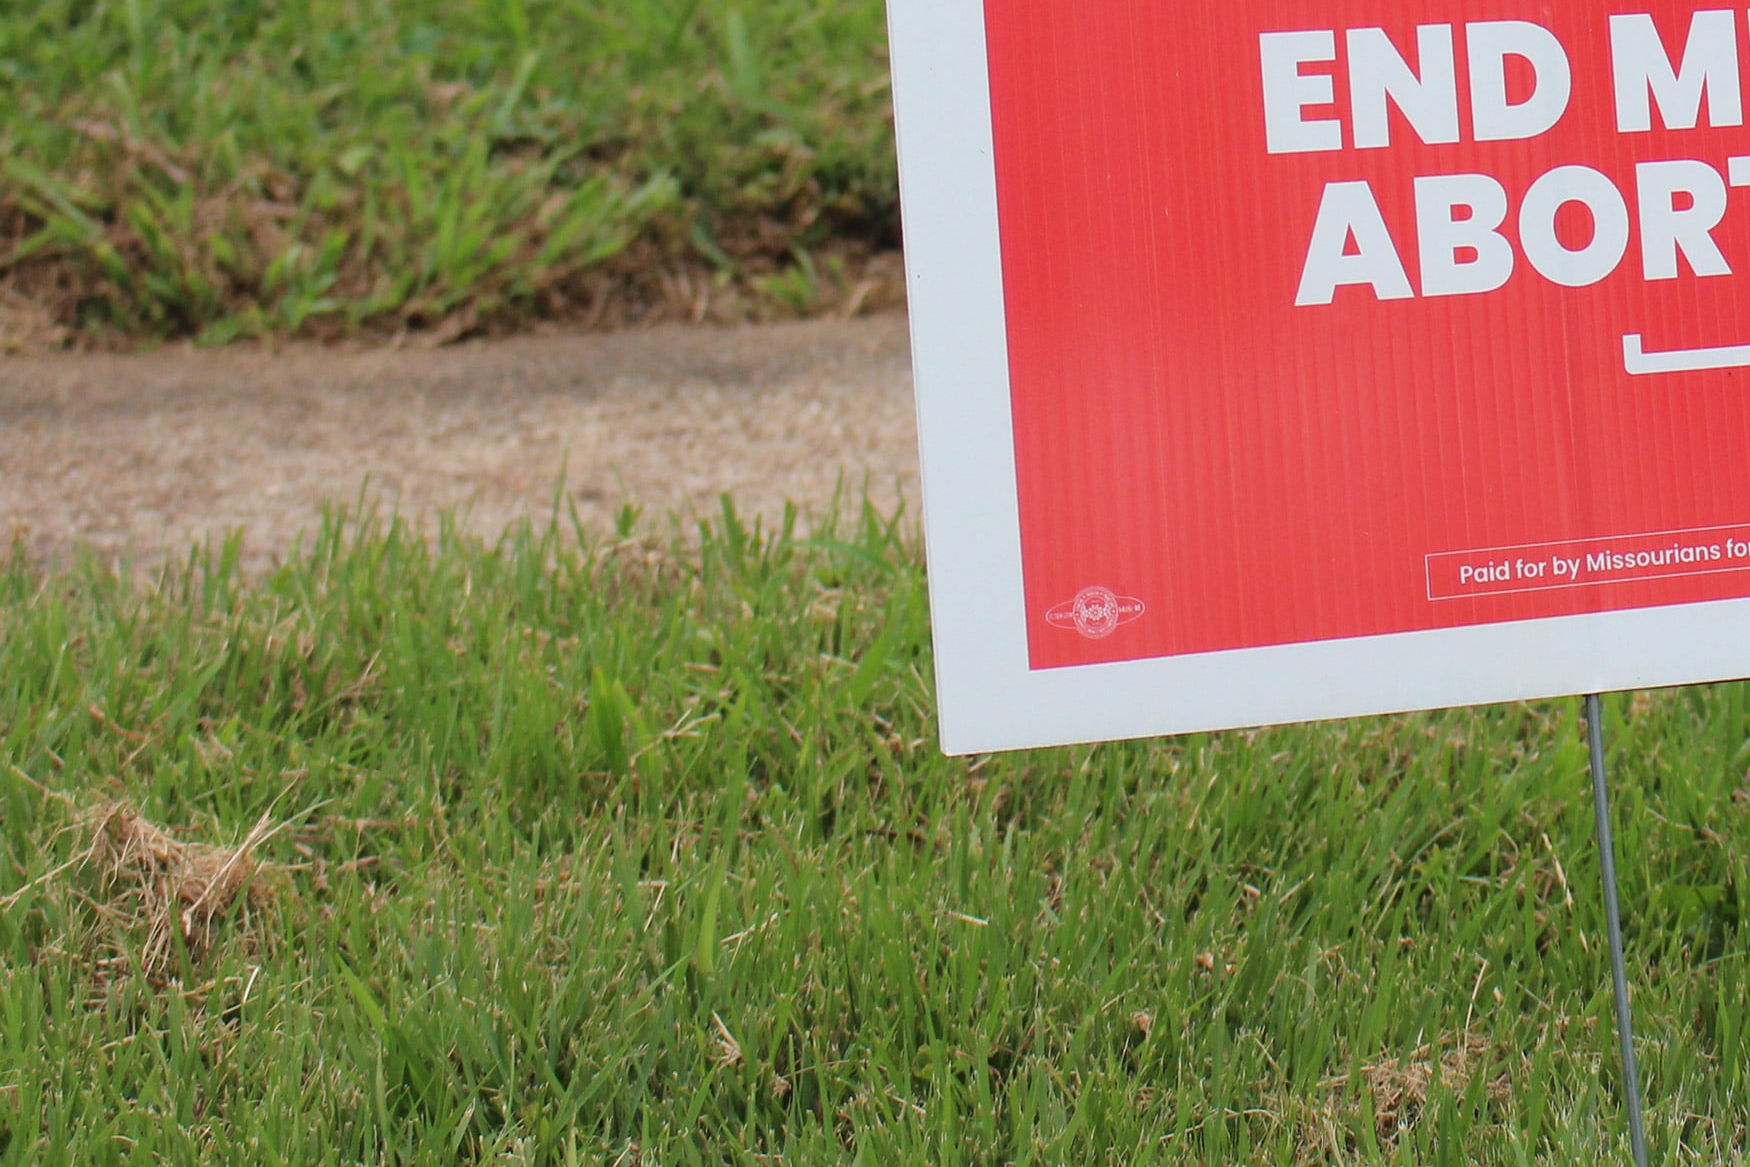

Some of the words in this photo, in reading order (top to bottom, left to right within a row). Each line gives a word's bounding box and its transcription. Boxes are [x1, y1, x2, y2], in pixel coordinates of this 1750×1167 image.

[1259, 21, 1571, 154] END
[1460, 560, 1511, 584] Paid
[1515, 558, 1547, 579] for
[1552, 556, 1581, 580] by
[1586, 543, 1721, 572] Missourians
